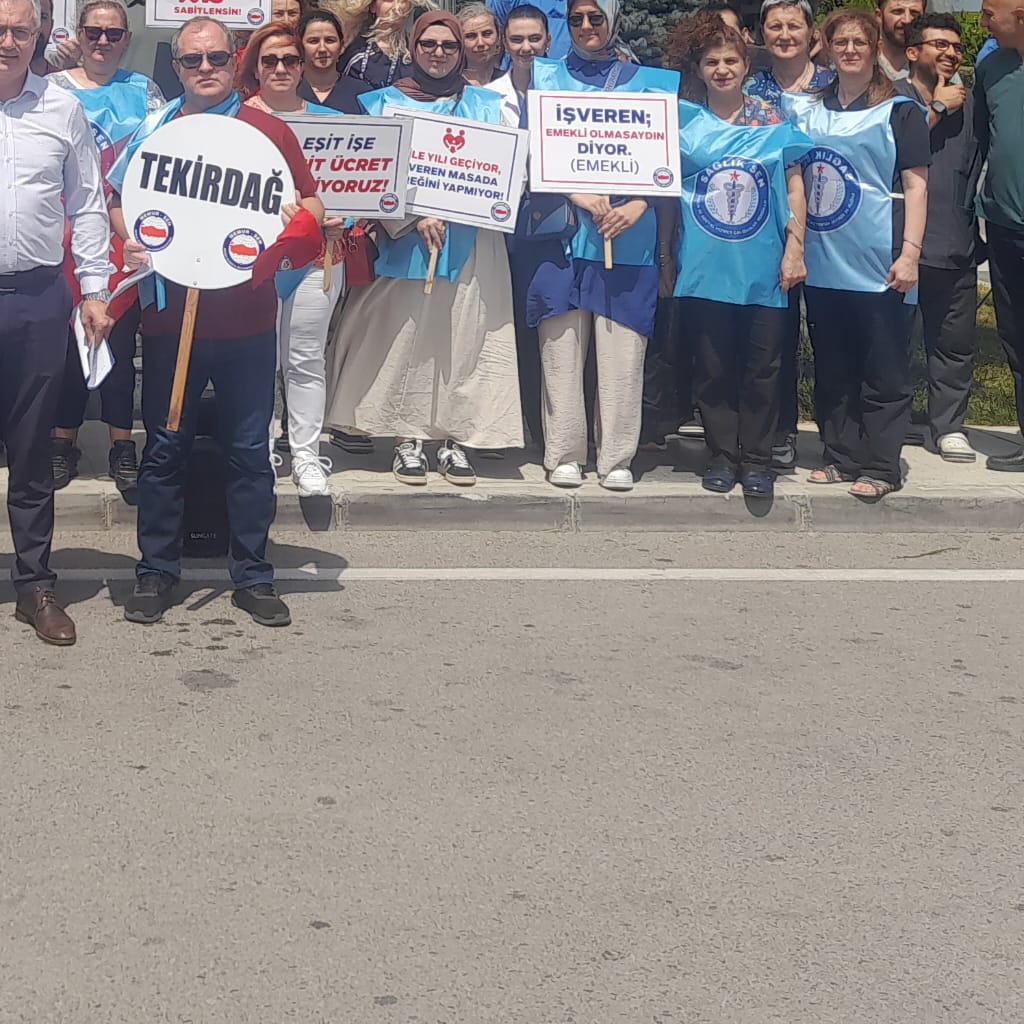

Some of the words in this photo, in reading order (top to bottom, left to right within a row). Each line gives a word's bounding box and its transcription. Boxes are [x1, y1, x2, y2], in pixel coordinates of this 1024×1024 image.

[174, 6, 242, 16] SABİTLENSİN!
[556, 104, 652, 128] İŞVEREN;
[303, 133, 344, 152] EŞİT
[347, 134, 376, 152] İŞE
[546, 128, 587, 138] EMEKLİ
[589, 130, 665, 140] OLMASAYDIN
[578, 140, 632, 156] DİYOR.
[330, 155, 393, 171] ÜCRET
[428, 153, 448, 164] YILI
[450, 157, 501, 175] GEÇİYOR,
[570, 158, 640, 175] (EMEKLİ)
[139, 151, 284, 216] TEKİRDAĞ
[409, 163, 446, 177] VEREN
[448, 170, 498, 187] MASADA
[749, 164, 765, 188] SEN
[315, 177, 389, 193] İYORUZ!
[408, 176, 440, 189] EĞİNİ
[443, 182, 504, 201] YAPMIYOR!
